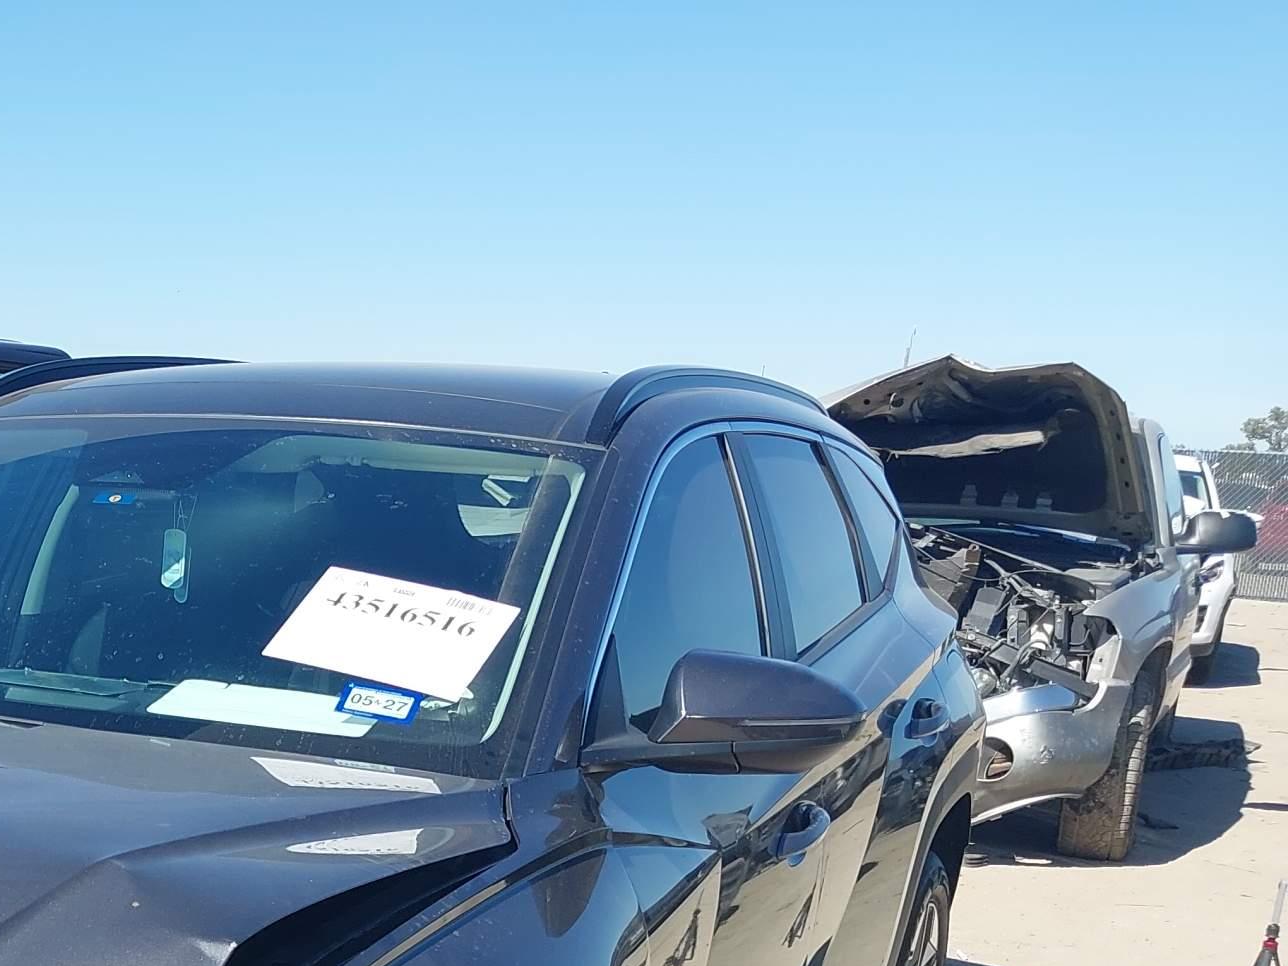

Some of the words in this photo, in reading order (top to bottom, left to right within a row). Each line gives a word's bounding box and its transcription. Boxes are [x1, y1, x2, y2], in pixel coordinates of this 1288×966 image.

[326, 591, 477, 637] 43516516
[350, 693, 374, 706] 05
[383, 699, 408, 711] 27
